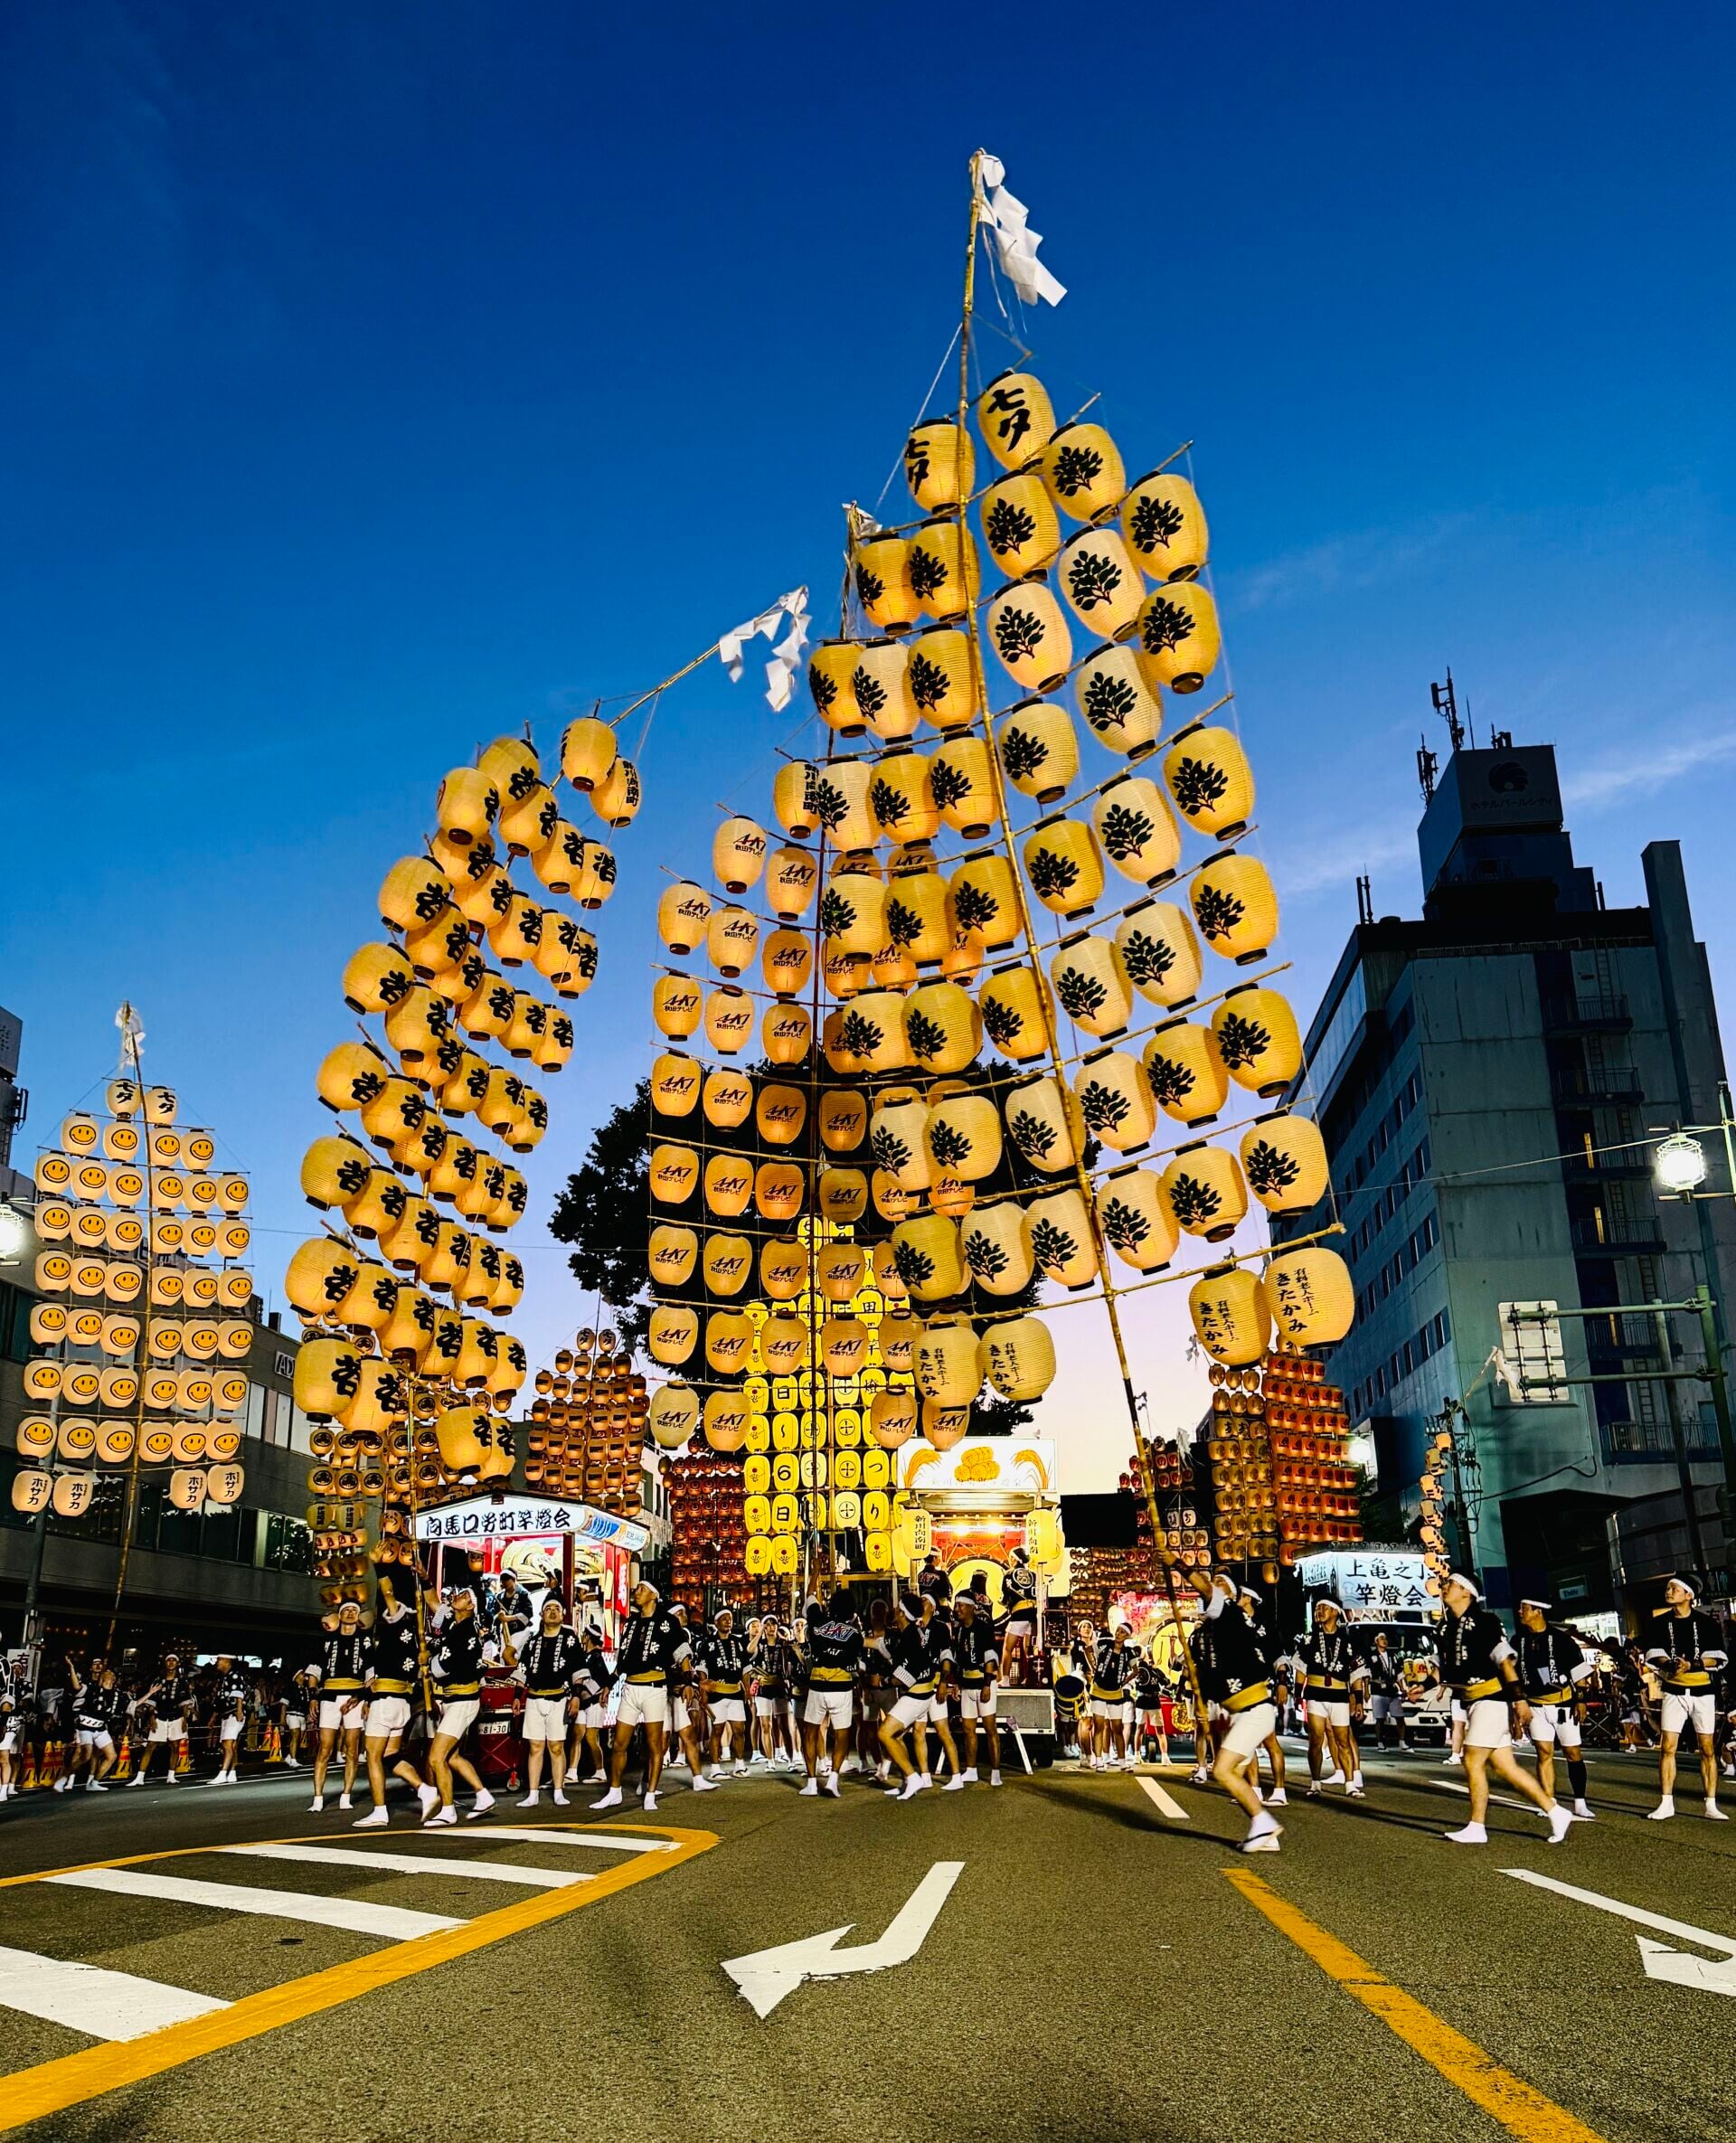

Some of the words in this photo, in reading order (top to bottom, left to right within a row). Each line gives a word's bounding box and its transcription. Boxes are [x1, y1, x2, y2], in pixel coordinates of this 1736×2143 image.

[986, 387, 1030, 451] 七夕
[905, 438, 930, 495] 七夕
[116, 1081, 135, 1113] 七夕
[158, 1090, 175, 1115] 七夕
[1277, 1272, 1307, 1333] きたかみ
[1199, 1301, 1229, 1355] きたかみ
[919, 1348, 939, 1397] きたかみ
[989, 1344, 1016, 1393] きたかみ
[224, 1471, 236, 1497] ホサカ
[778, 1465, 791, 1480] 6
[27, 1477, 43, 1506] ホサカ
[69, 1483, 83, 1510] ホサカ
[186, 1477, 199, 1503] ホサカ
[1355, 1583, 1427, 1607] 竿燈会
